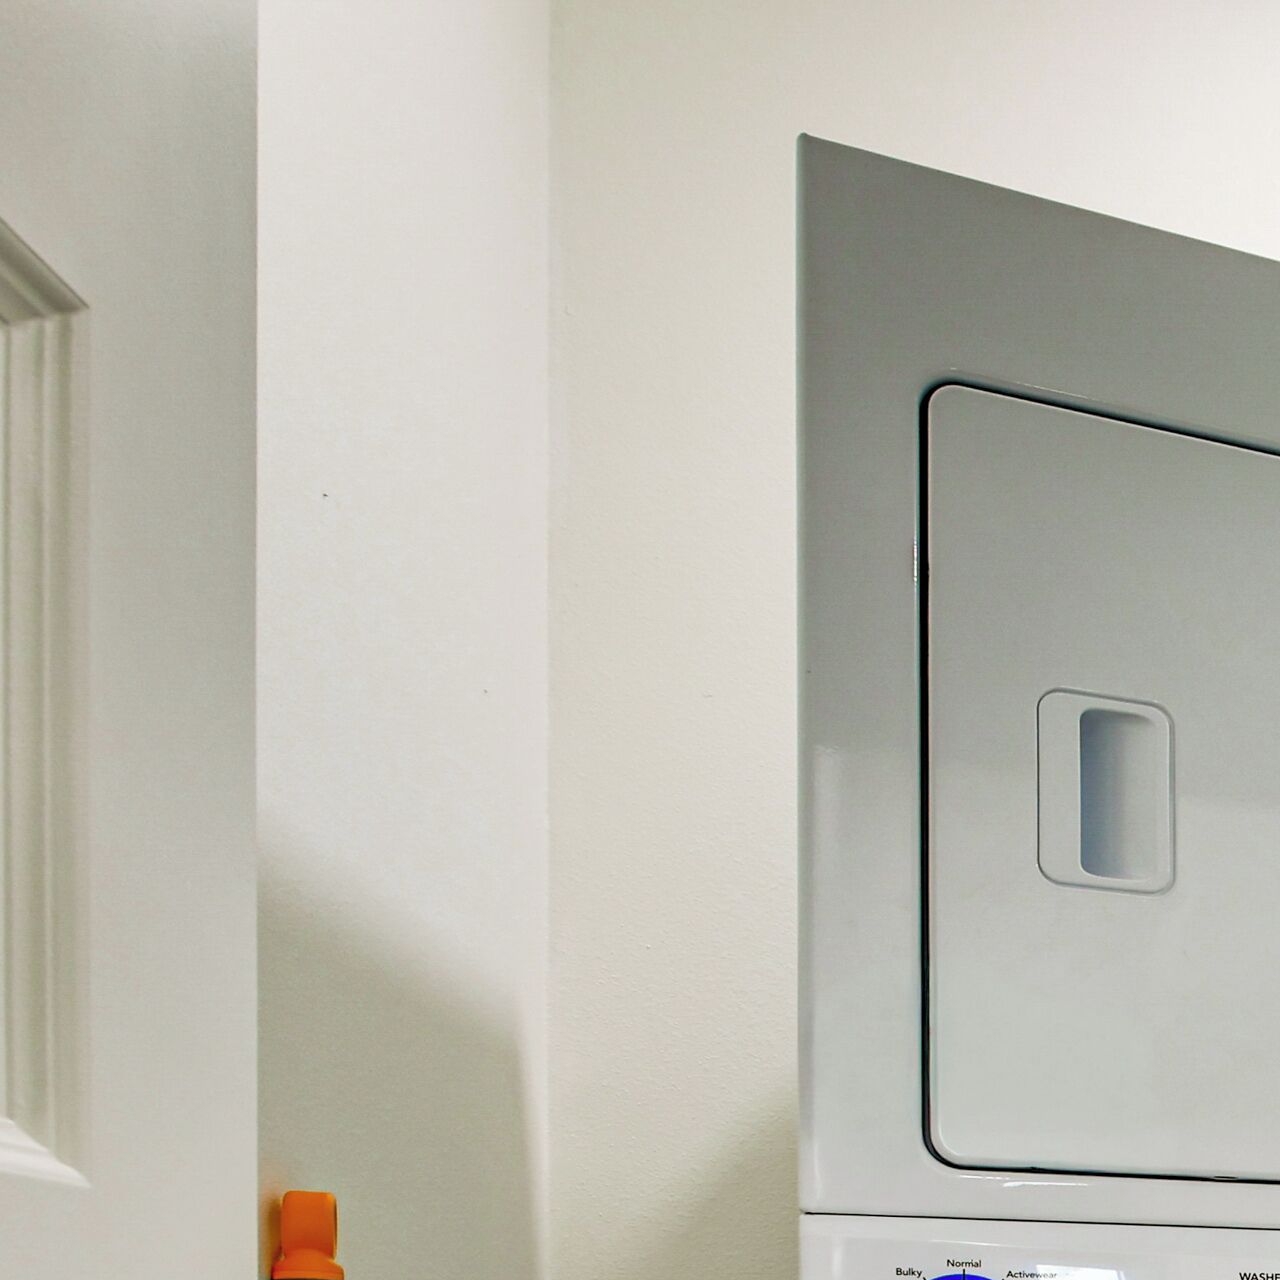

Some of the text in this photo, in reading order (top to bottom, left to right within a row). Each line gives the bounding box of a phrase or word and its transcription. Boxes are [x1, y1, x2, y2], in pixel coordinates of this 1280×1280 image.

[946, 1259, 982, 1268] Normal
[896, 1267, 923, 1279] Bulky
[1006, 1269, 1057, 1280] Activewear
